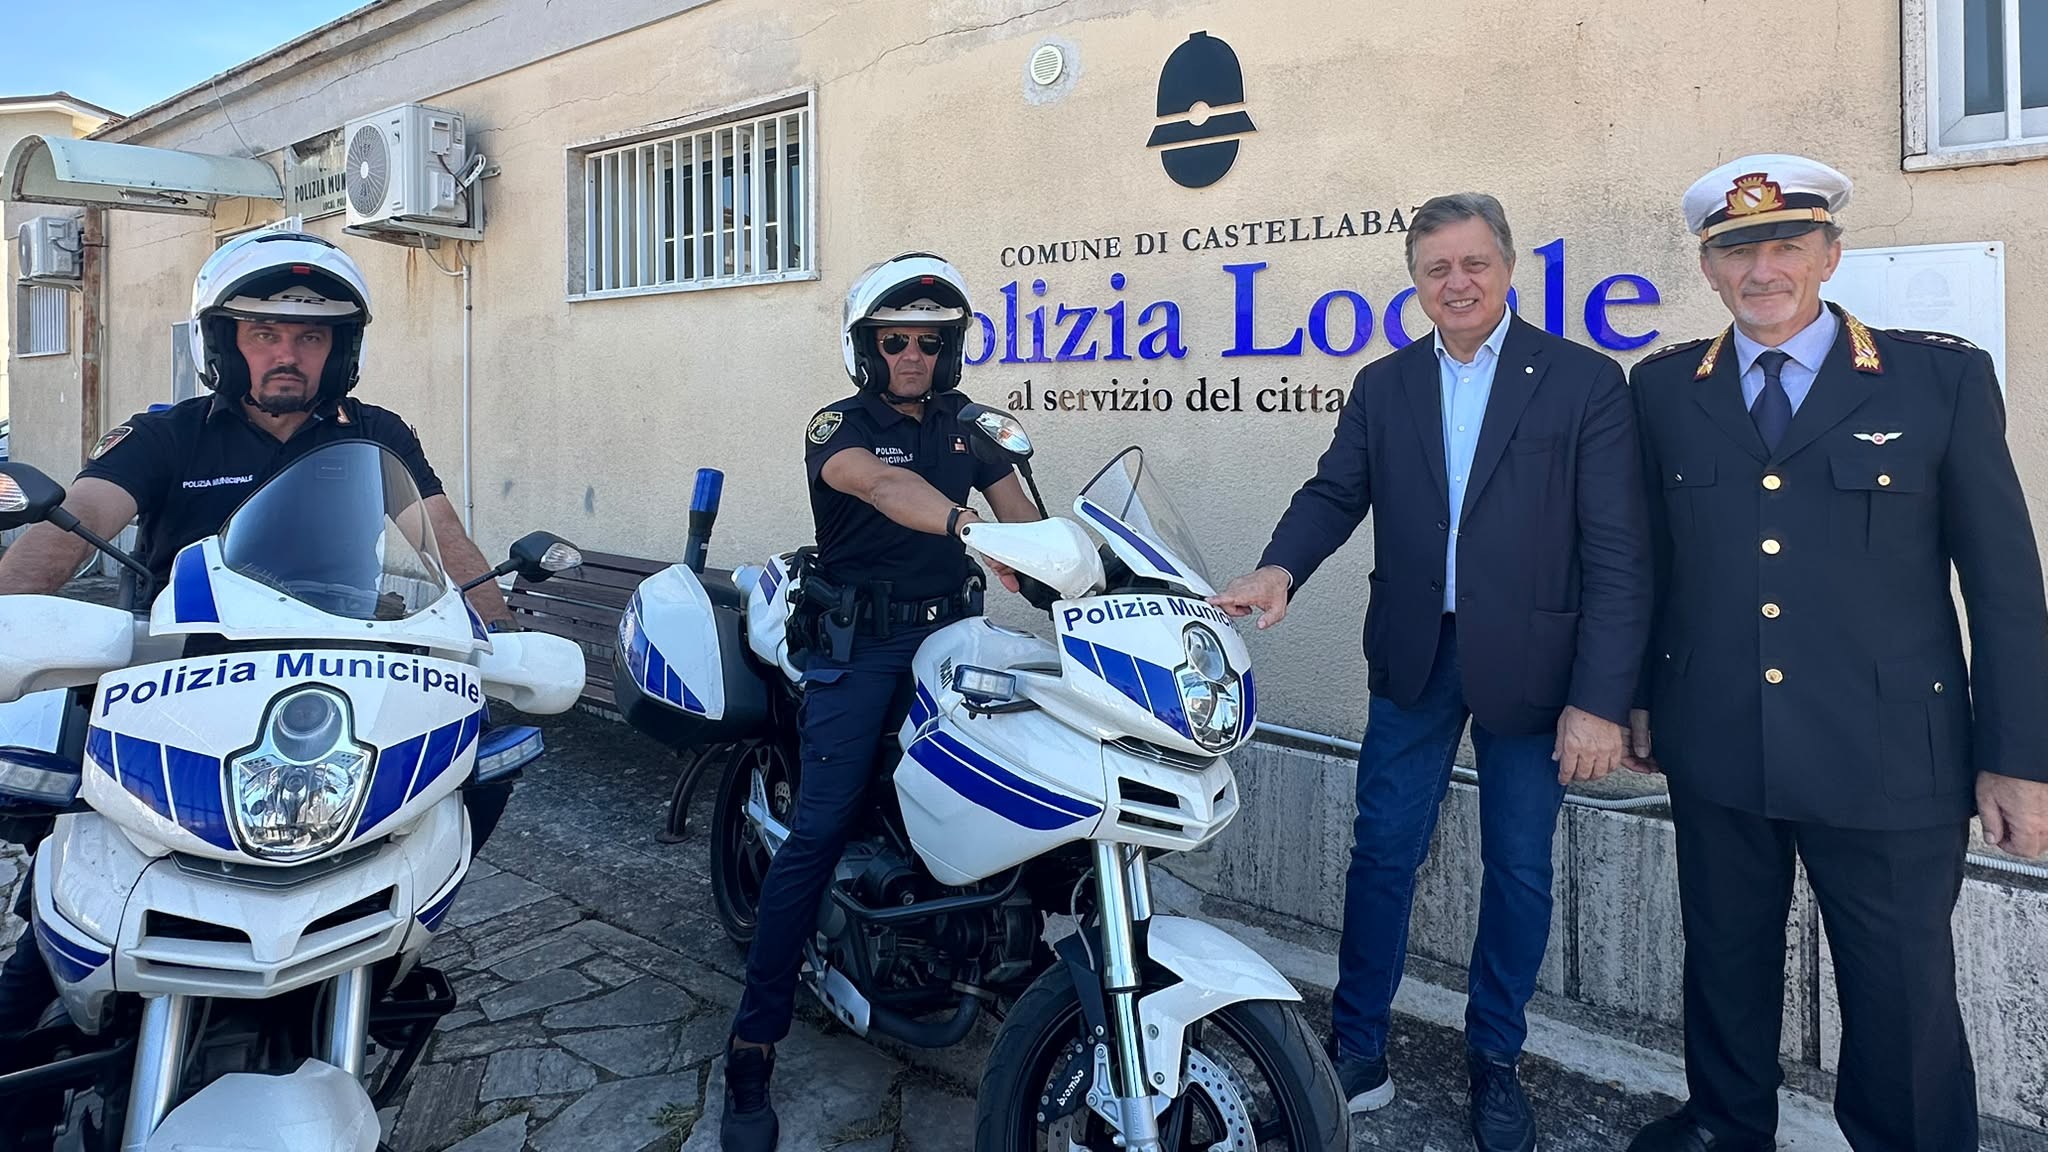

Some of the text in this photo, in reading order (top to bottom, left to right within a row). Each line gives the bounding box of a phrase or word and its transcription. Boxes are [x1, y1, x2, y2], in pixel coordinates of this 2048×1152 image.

[294, 178, 326, 204] POLIZIA
[1000, 205, 1421, 268] COMUNE DI CASTELLABA
[964, 237, 1661, 366] olizia Locle
[1007, 379, 1035, 412] al
[1043, 378, 1173, 412] servizio
[1186, 376, 1242, 412] del
[875, 447, 904, 455] POLIZIA
[182, 474, 253, 489] POLIZIA MUNICIPALE
[1063, 596, 1164, 632] Polizia
[101, 652, 480, 717] Polizia Municipale
[1057, 1069, 1084, 1106] brembo
